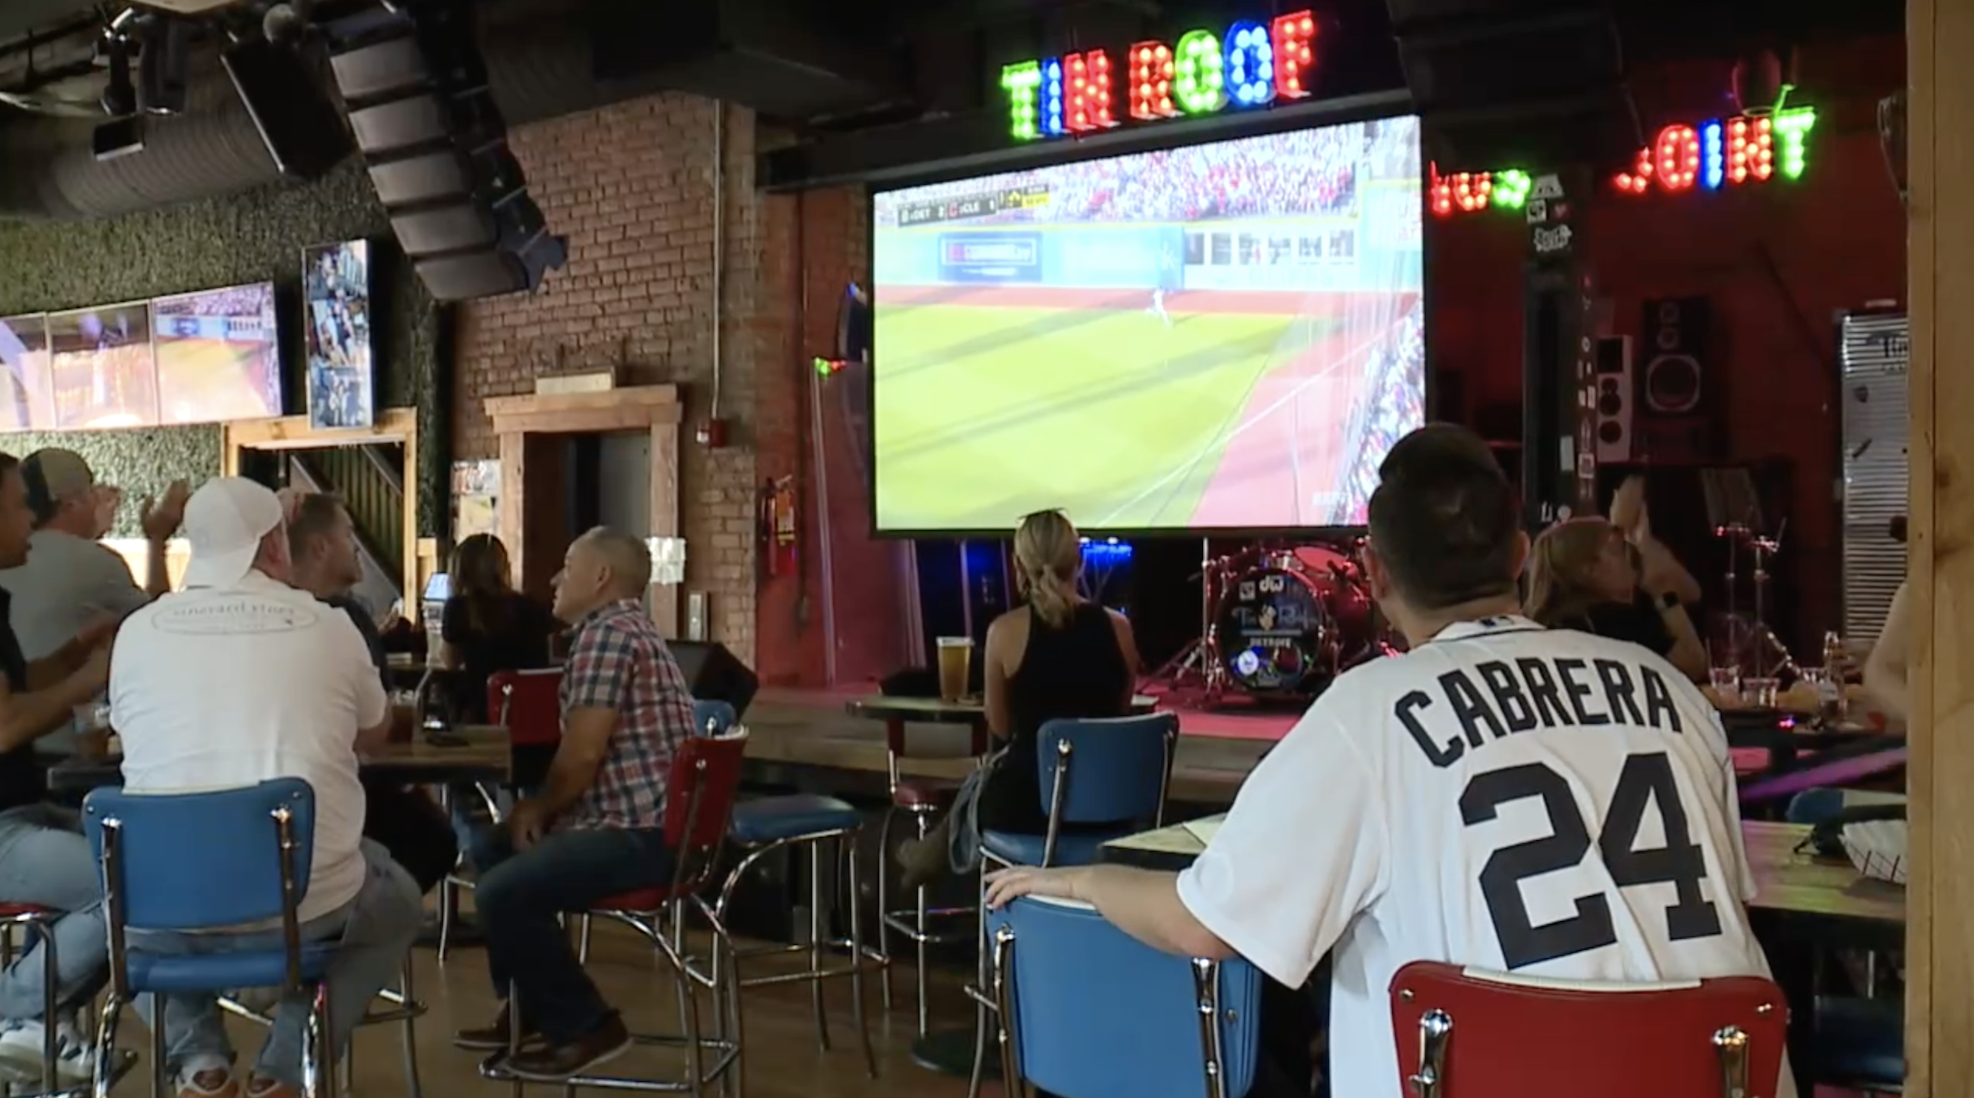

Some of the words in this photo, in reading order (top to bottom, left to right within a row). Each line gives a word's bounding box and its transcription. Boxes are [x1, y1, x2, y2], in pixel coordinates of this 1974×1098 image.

[1001, 50, 1110, 138] TIN
[1129, 10, 1314, 117] ROOF
[1395, 657, 1683, 768] CABRERA
[1458, 751, 1722, 971] 24
